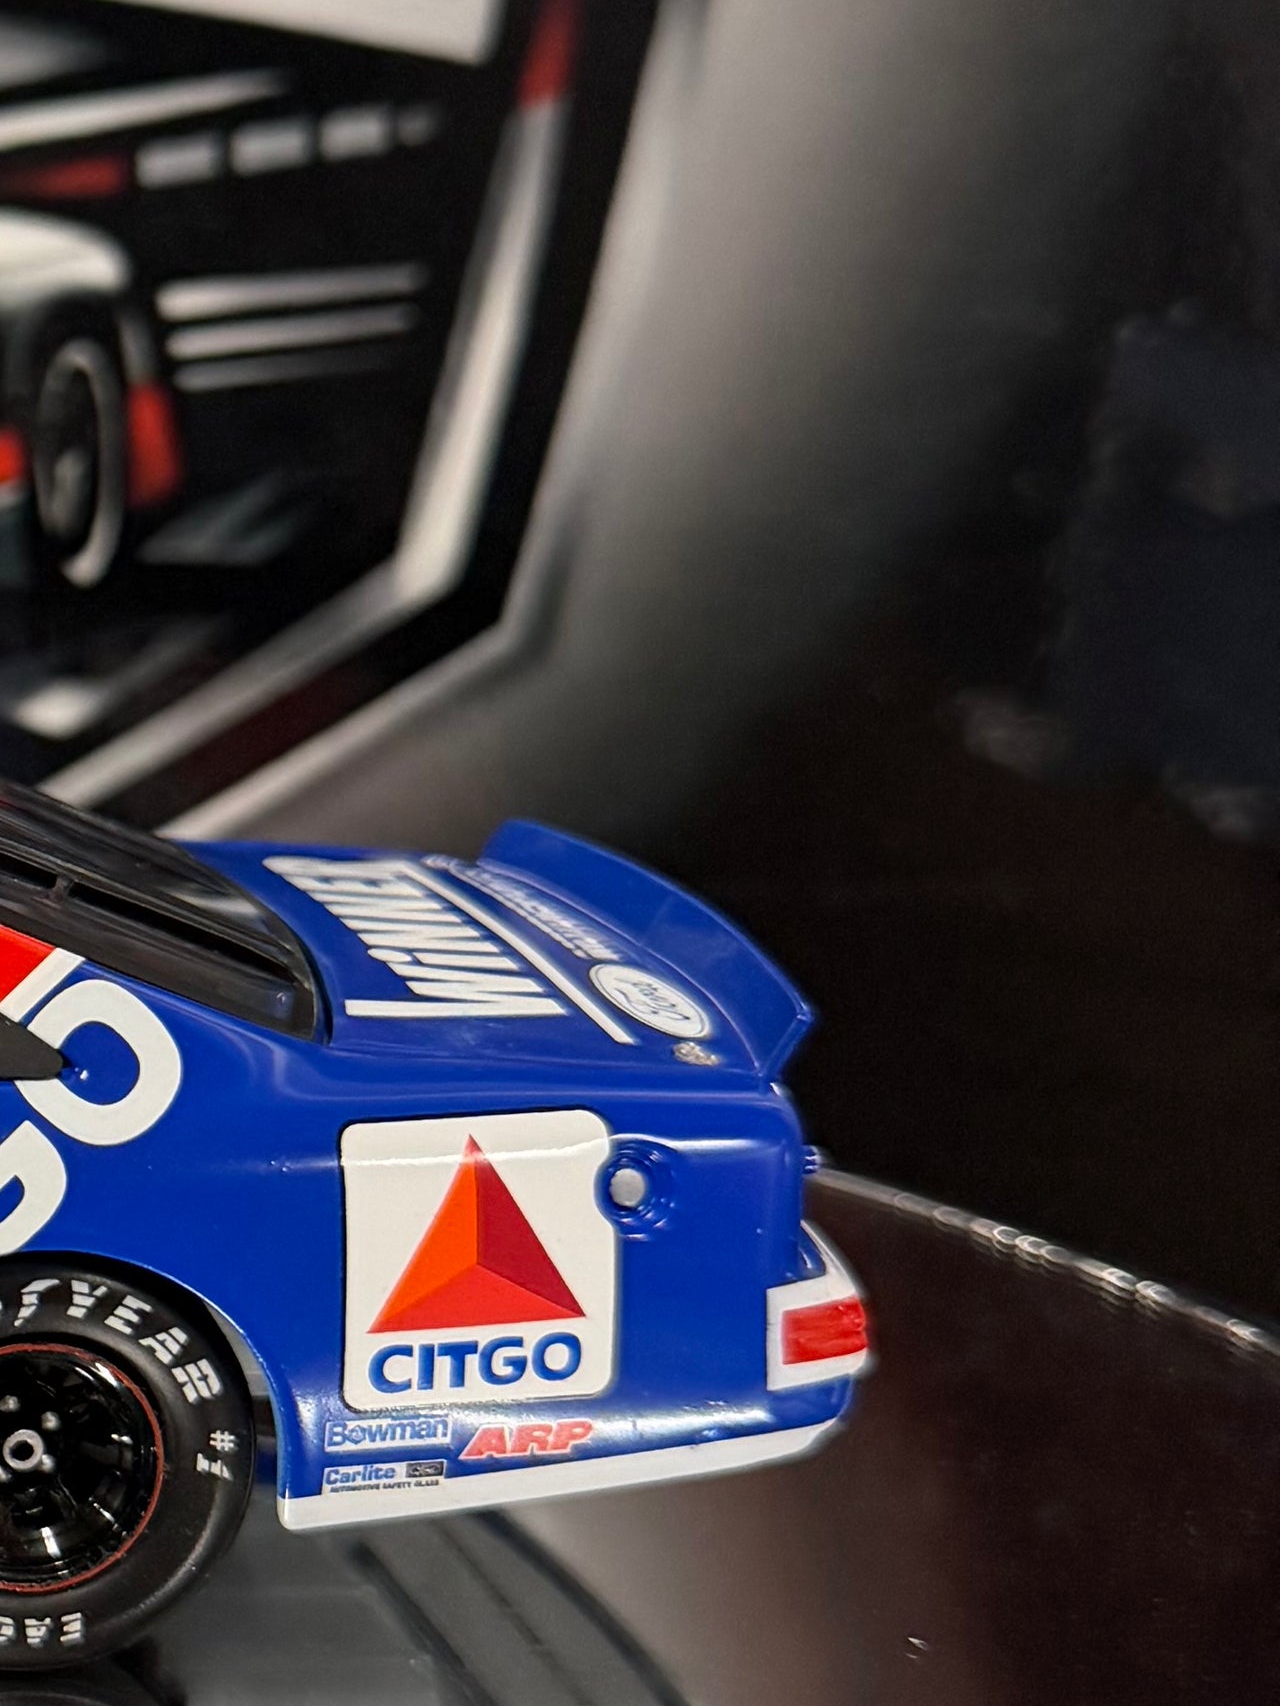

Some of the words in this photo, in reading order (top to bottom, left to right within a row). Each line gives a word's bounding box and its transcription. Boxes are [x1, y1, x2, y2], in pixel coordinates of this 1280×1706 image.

[367, 1332, 582, 1393] CITGO
[328, 1417, 449, 1445] Bowman
[458, 1418, 593, 1459] ARP
[325, 1464, 396, 1485] Carlite
